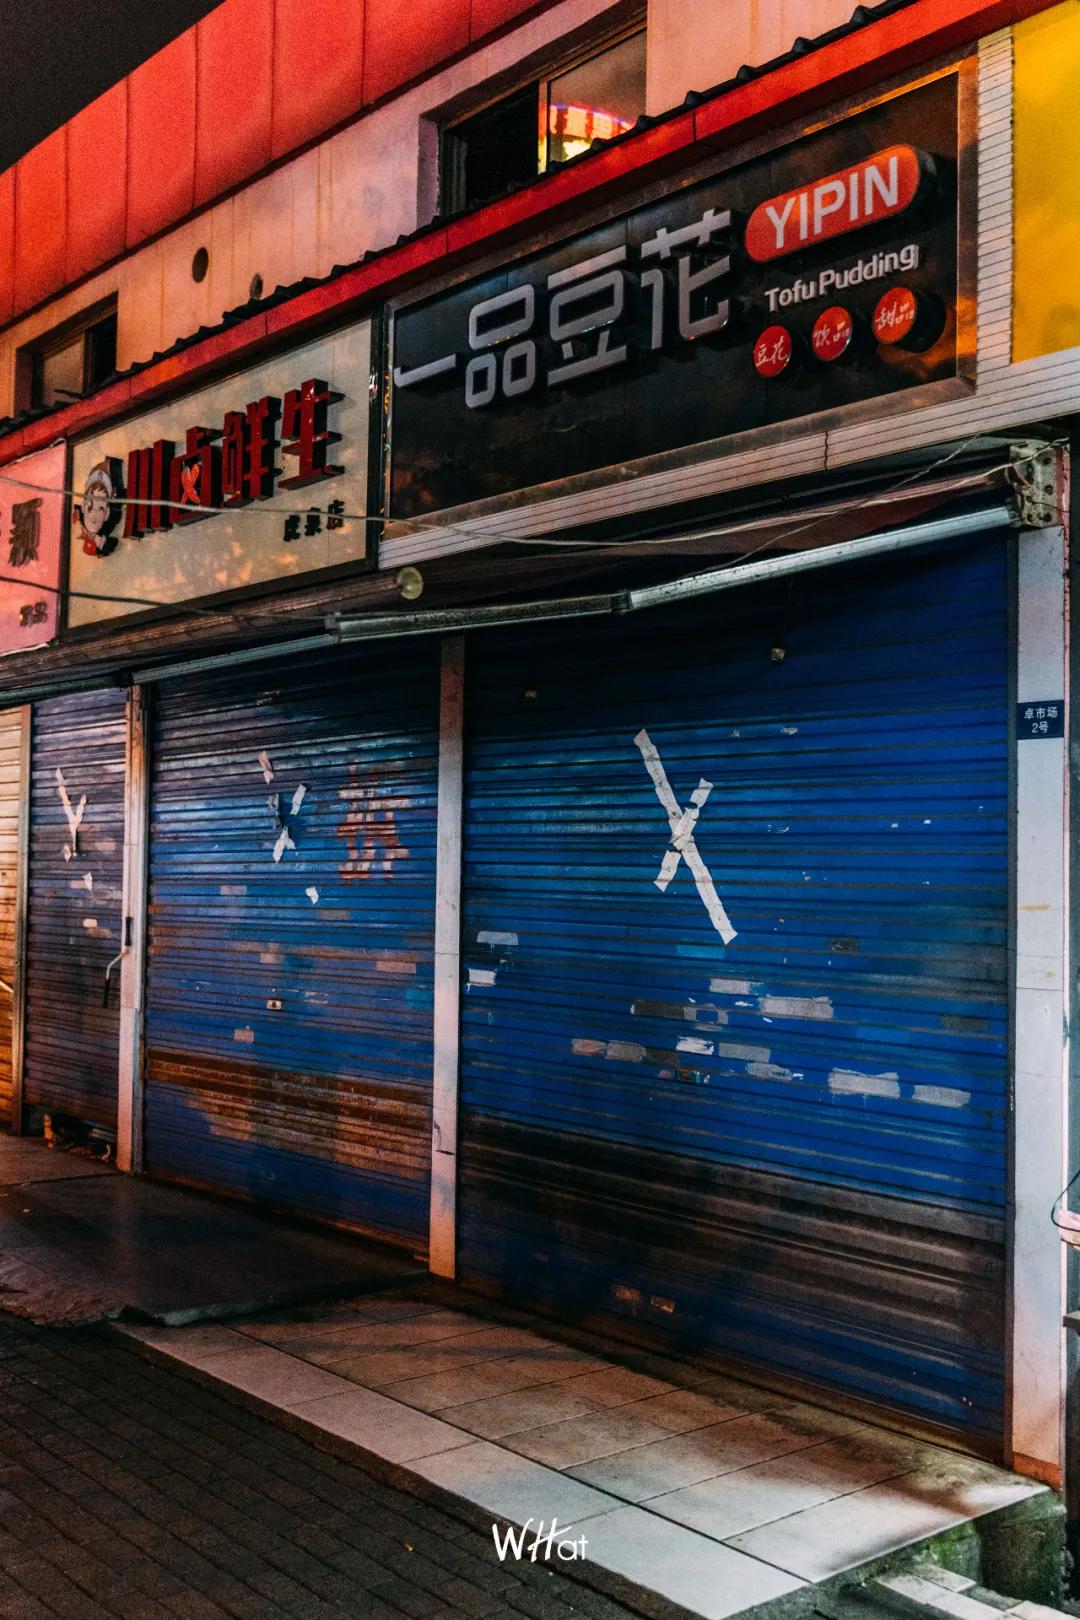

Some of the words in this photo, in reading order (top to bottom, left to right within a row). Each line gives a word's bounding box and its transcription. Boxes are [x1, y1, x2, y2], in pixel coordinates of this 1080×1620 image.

[764, 156, 899, 248] YIPIN
[764, 279, 817, 312] Tofu
[819, 243, 919, 295] Pudding
[394, 208, 731, 409] 一品豆花
[874, 301, 915, 331] 甜品
[756, 335, 789, 367] 豆花
[1031, 721, 1049, 734] 2号
